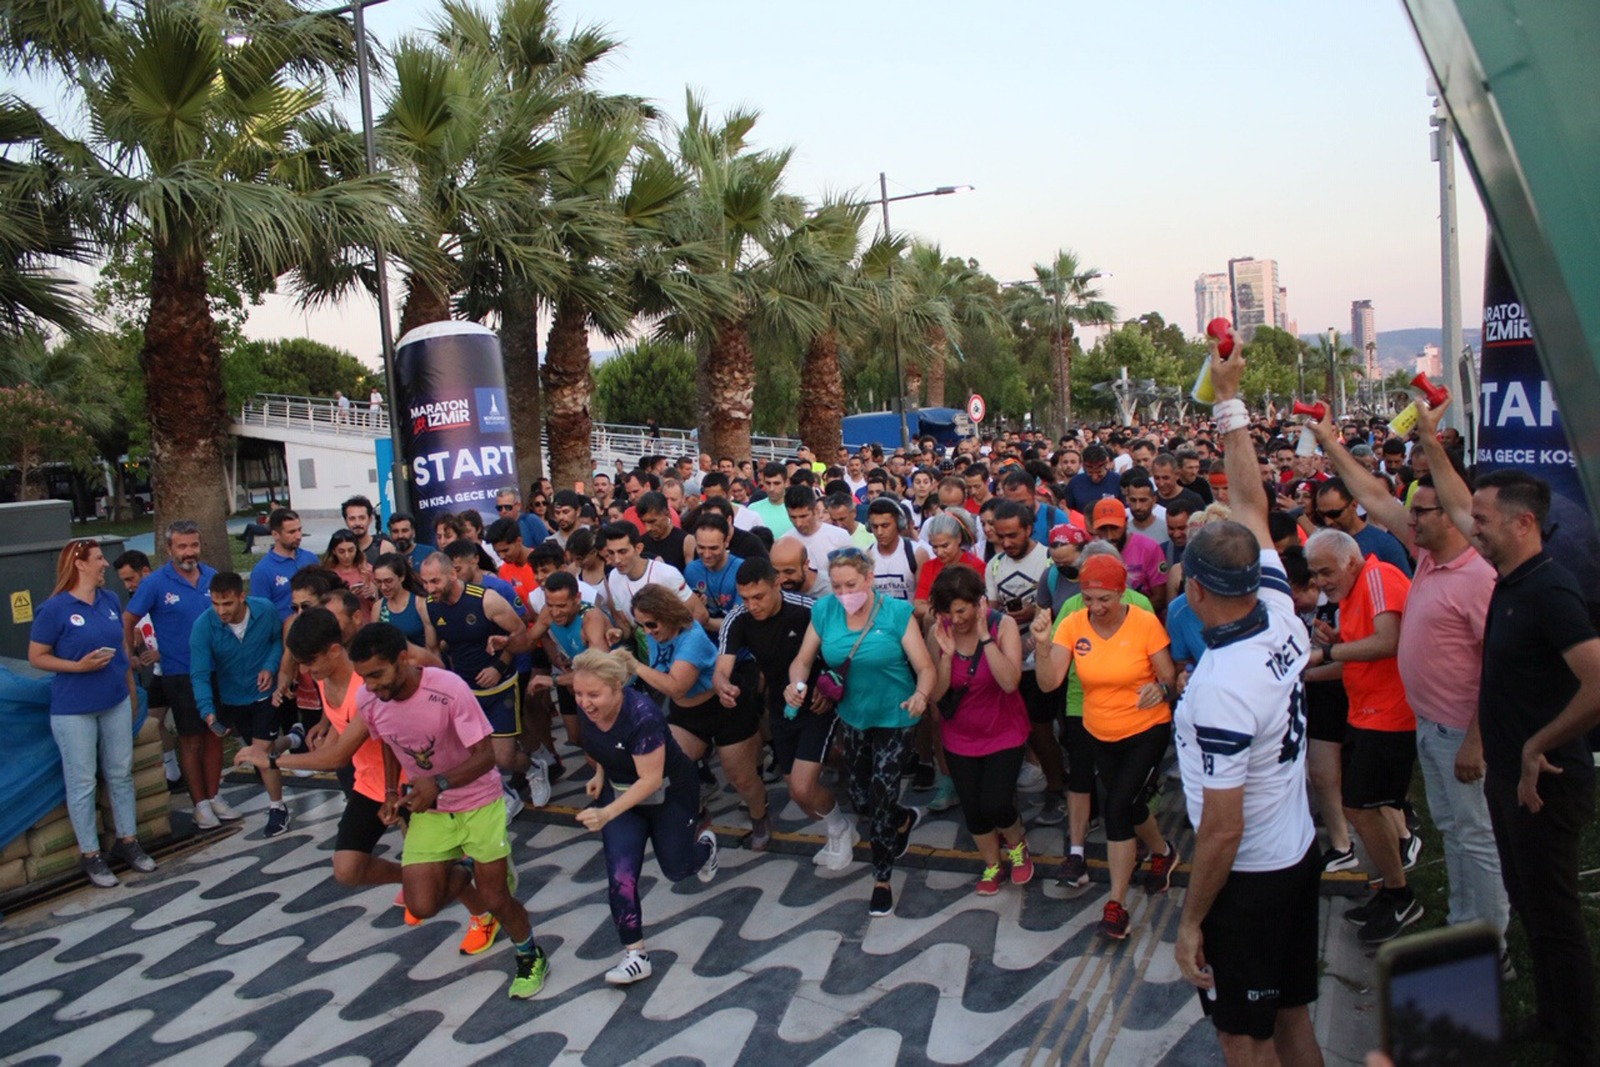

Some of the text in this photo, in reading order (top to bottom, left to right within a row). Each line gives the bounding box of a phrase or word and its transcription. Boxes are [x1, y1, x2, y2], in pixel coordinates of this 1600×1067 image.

[410, 399, 469, 418] MARATON
[1494, 449, 1536, 463] GECE
[412, 446, 514, 487] START
[419, 498, 429, 509] EN
[429, 494, 453, 507] KISA
[454, 490, 486, 503] GECE
